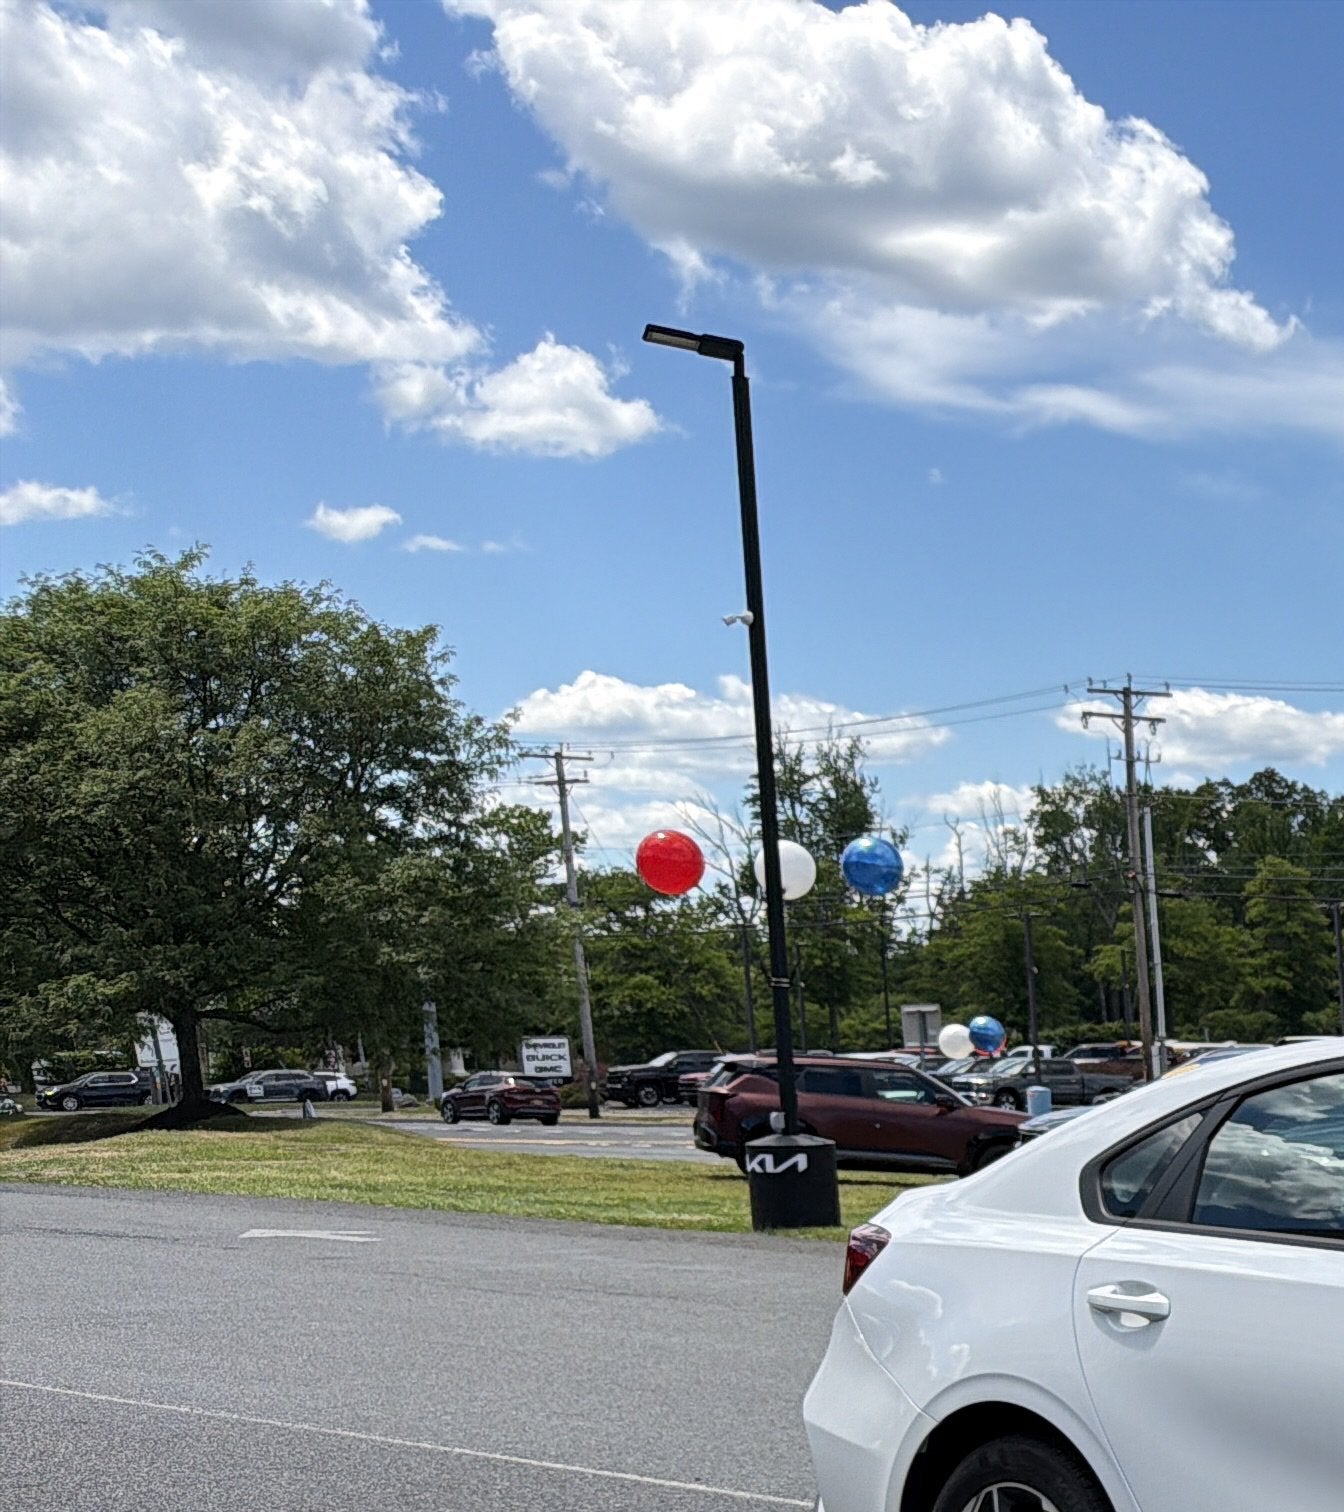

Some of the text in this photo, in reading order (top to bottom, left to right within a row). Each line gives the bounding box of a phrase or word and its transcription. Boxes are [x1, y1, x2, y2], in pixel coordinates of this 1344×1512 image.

[525, 1054, 568, 1062] BUICK
[534, 1065, 563, 1074] GMC
[745, 1152, 808, 1174] KIA
